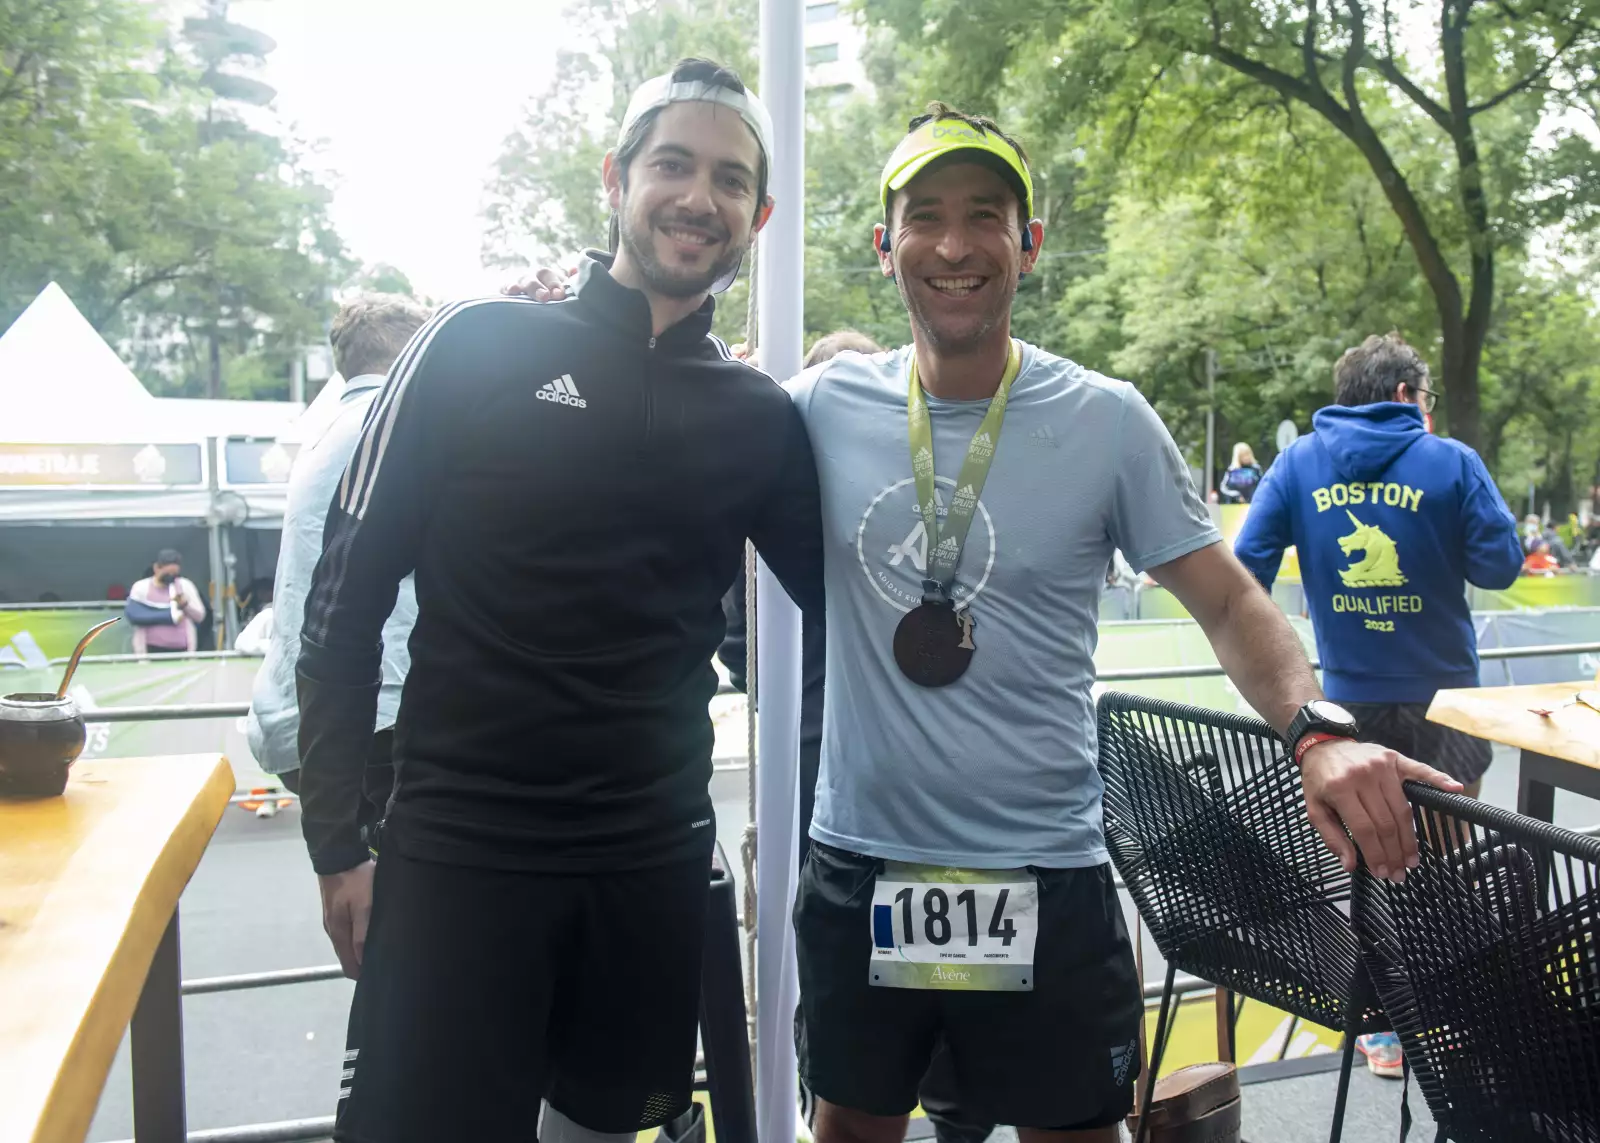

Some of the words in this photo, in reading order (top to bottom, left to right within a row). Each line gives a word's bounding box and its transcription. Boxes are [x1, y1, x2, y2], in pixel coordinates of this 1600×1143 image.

[535, 389, 587, 409] adidas
[968, 445, 992, 457] SPLITS
[952, 496, 975, 508] SPLITS
[954, 490, 977, 500] adidas
[1311, 481, 1424, 513] BOSTON
[935, 549, 958, 560] SPLITS
[938, 543, 960, 552] adidas
[877, 571, 903, 597] ADIDAS
[1332, 594, 1423, 615] QUALIFIED
[1363, 619, 1396, 632] 2022
[1297, 737, 1318, 756] ULTRA
[894, 887, 1018, 947] 1814
[930, 964, 971, 981] Avène
[1115, 1038, 1136, 1087] adidas
